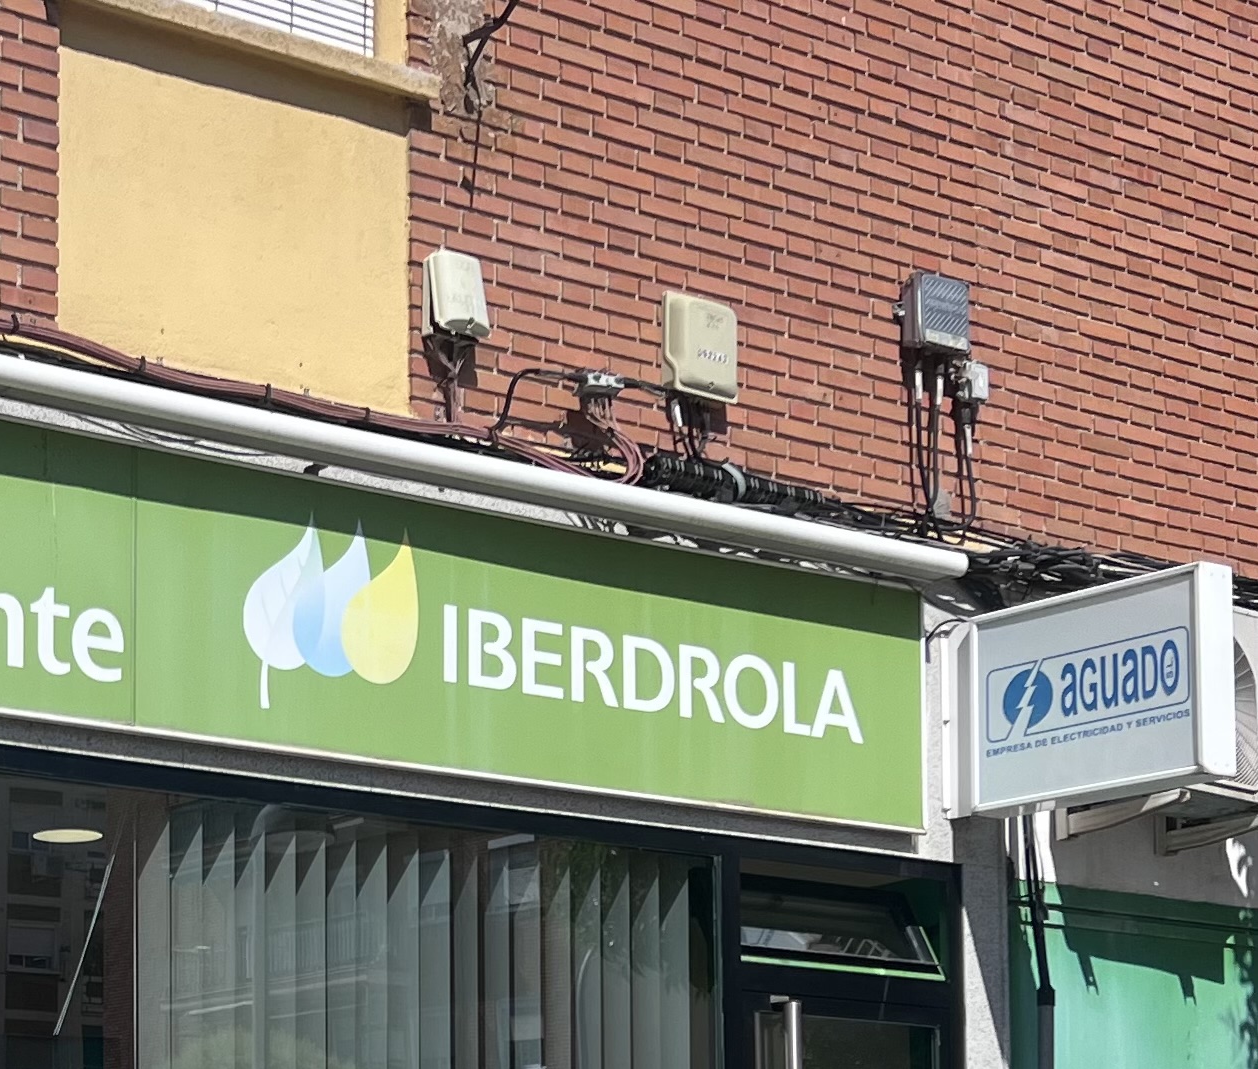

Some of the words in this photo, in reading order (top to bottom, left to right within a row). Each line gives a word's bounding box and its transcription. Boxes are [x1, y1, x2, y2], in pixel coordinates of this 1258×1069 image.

[443, 604, 864, 744] IBERDROLA
[986, 742, 1032, 758] EMPRESA
[1035, 738, 1048, 748] DE
[1051, 724, 1123, 746] ELECTRICIDAD
[1127, 720, 1134, 729] Y
[1136, 709, 1190, 728] SERVICIOS
